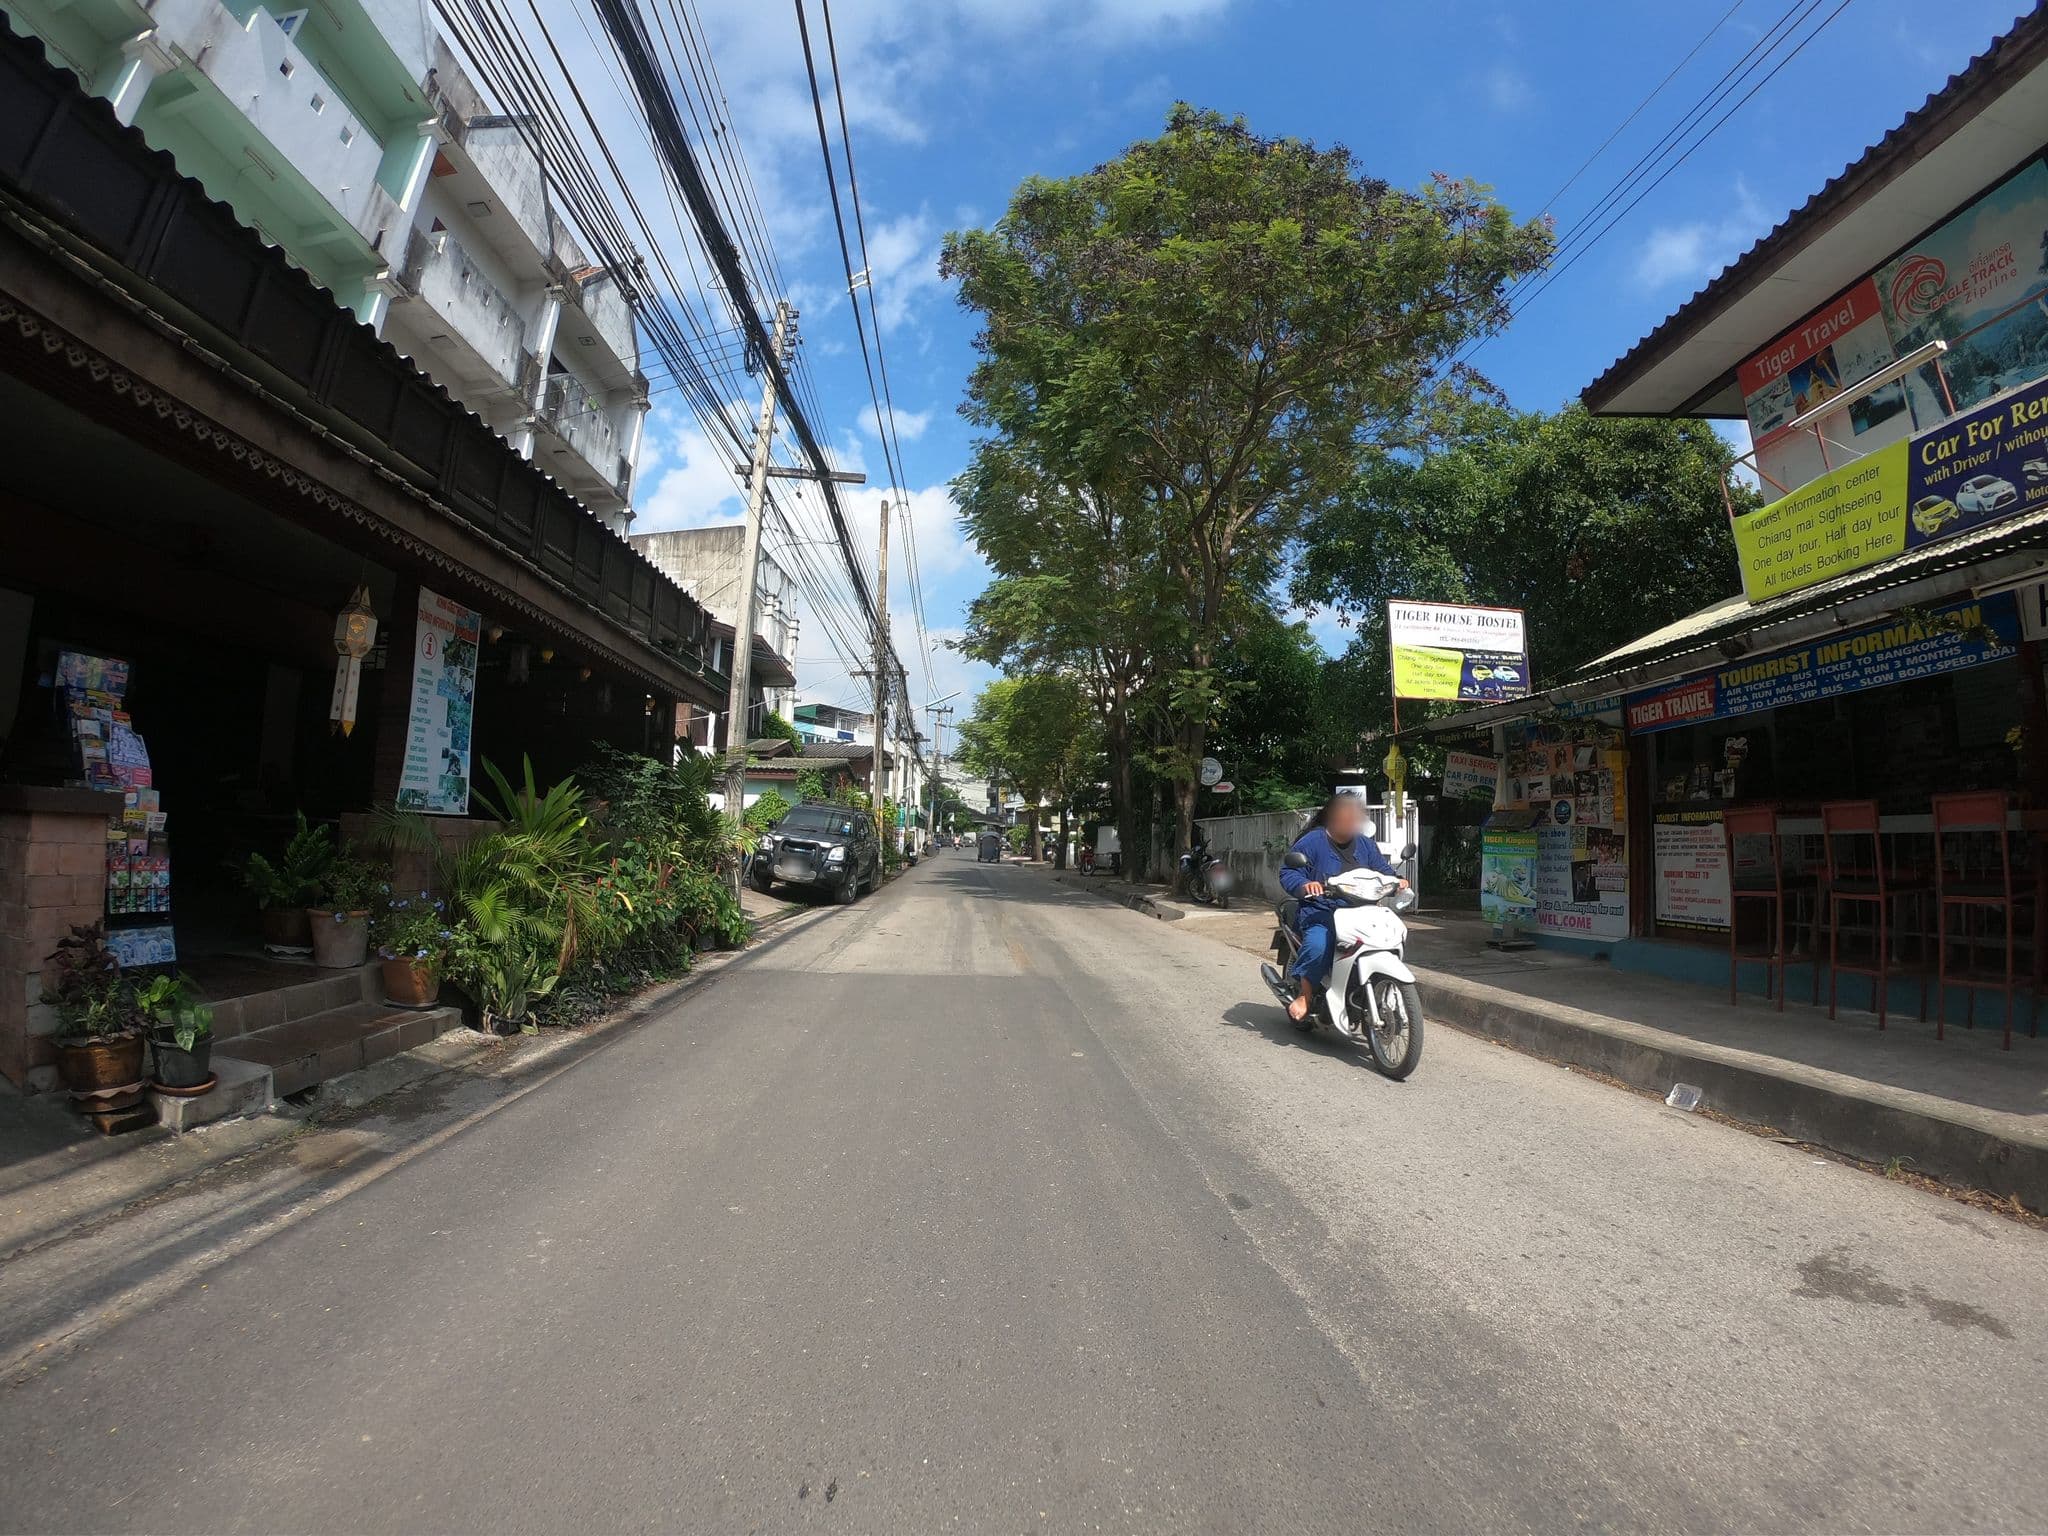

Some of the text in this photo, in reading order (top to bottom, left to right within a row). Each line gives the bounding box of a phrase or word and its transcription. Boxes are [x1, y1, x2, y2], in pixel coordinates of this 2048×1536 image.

[1929, 251, 2014, 311] EAGLE TRACK
[1965, 268, 2017, 304] Zipline
[1755, 301, 1857, 380] Tiger Travel
[1921, 434, 1961, 466] Car
[1965, 414, 2004, 447] For
[1923, 466, 1951, 486] with
[1953, 449, 1992, 474] Driver
[1751, 465, 1880, 532] Tourist Information center
[1758, 488, 1882, 550] Chiang mai Sightseeing
[1752, 556, 1772, 572] One
[1776, 547, 1795, 564] day
[1825, 526, 1848, 545] Half
[1852, 516, 1873, 535] day
[1877, 505, 1901, 524] tour
[1764, 531, 1897, 588] All tickets Booking Here.
[1395, 608, 1431, 622] TIGER
[1434, 612, 1473, 627] HOUSE
[1477, 615, 1519, 630] HOSTEL
[1718, 649, 1810, 689] TOURRIST
[1816, 604, 1983, 666] INFORMAON
[1726, 688, 1742, 697] AIR
[1743, 679, 1777, 692] TICKET
[1792, 670, 1812, 682] BUS
[1815, 660, 1853, 676] TICKET
[1856, 656, 1872, 666] TO
[1727, 645, 1962, 706] VISA RUN MAESAI VISA RUN 3 MONTHS
[1728, 703, 1749, 714] TRIP
[1750, 701, 1764, 710] TO
[1800, 689, 1818, 700] VIP
[1821, 683, 1844, 695] BUS
[1859, 672, 1894, 686] SLOW
[1898, 654, 1978, 679] BOAT-SPEED
[1631, 702, 1664, 725] TIGER
[1664, 689, 1713, 718] TRAVEL
[1446, 770, 1462, 780] CAR
[1464, 773, 1478, 783] FOR
[1450, 754, 1467, 766] TAXI
[1469, 758, 1498, 772] SERVICE
